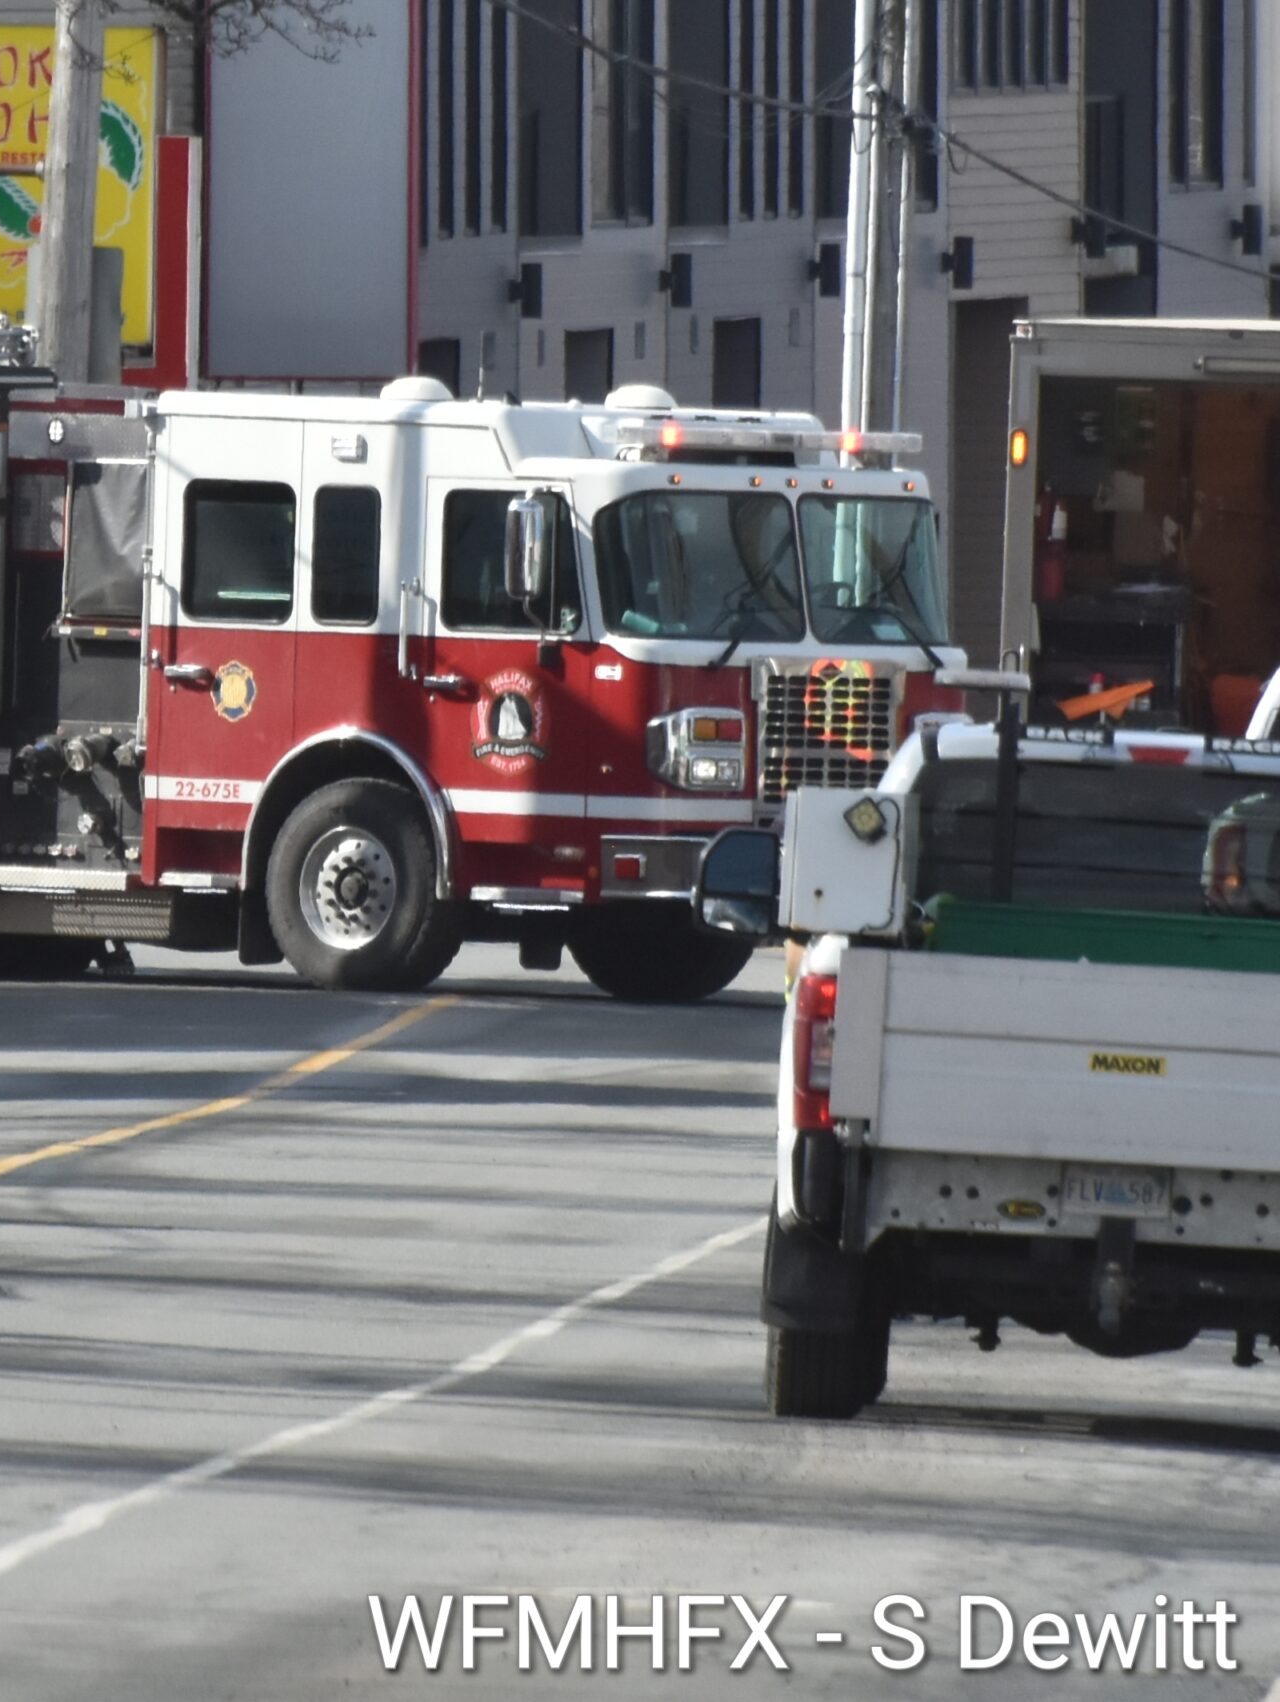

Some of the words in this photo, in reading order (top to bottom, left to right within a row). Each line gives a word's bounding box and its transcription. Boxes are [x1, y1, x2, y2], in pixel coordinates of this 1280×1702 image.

[489, 671, 534, 691] HALIFAX
[175, 781, 240, 799] 22-675E
[1091, 1053, 1160, 1075] MAXON
[1066, 1178, 1104, 1202] FLV
